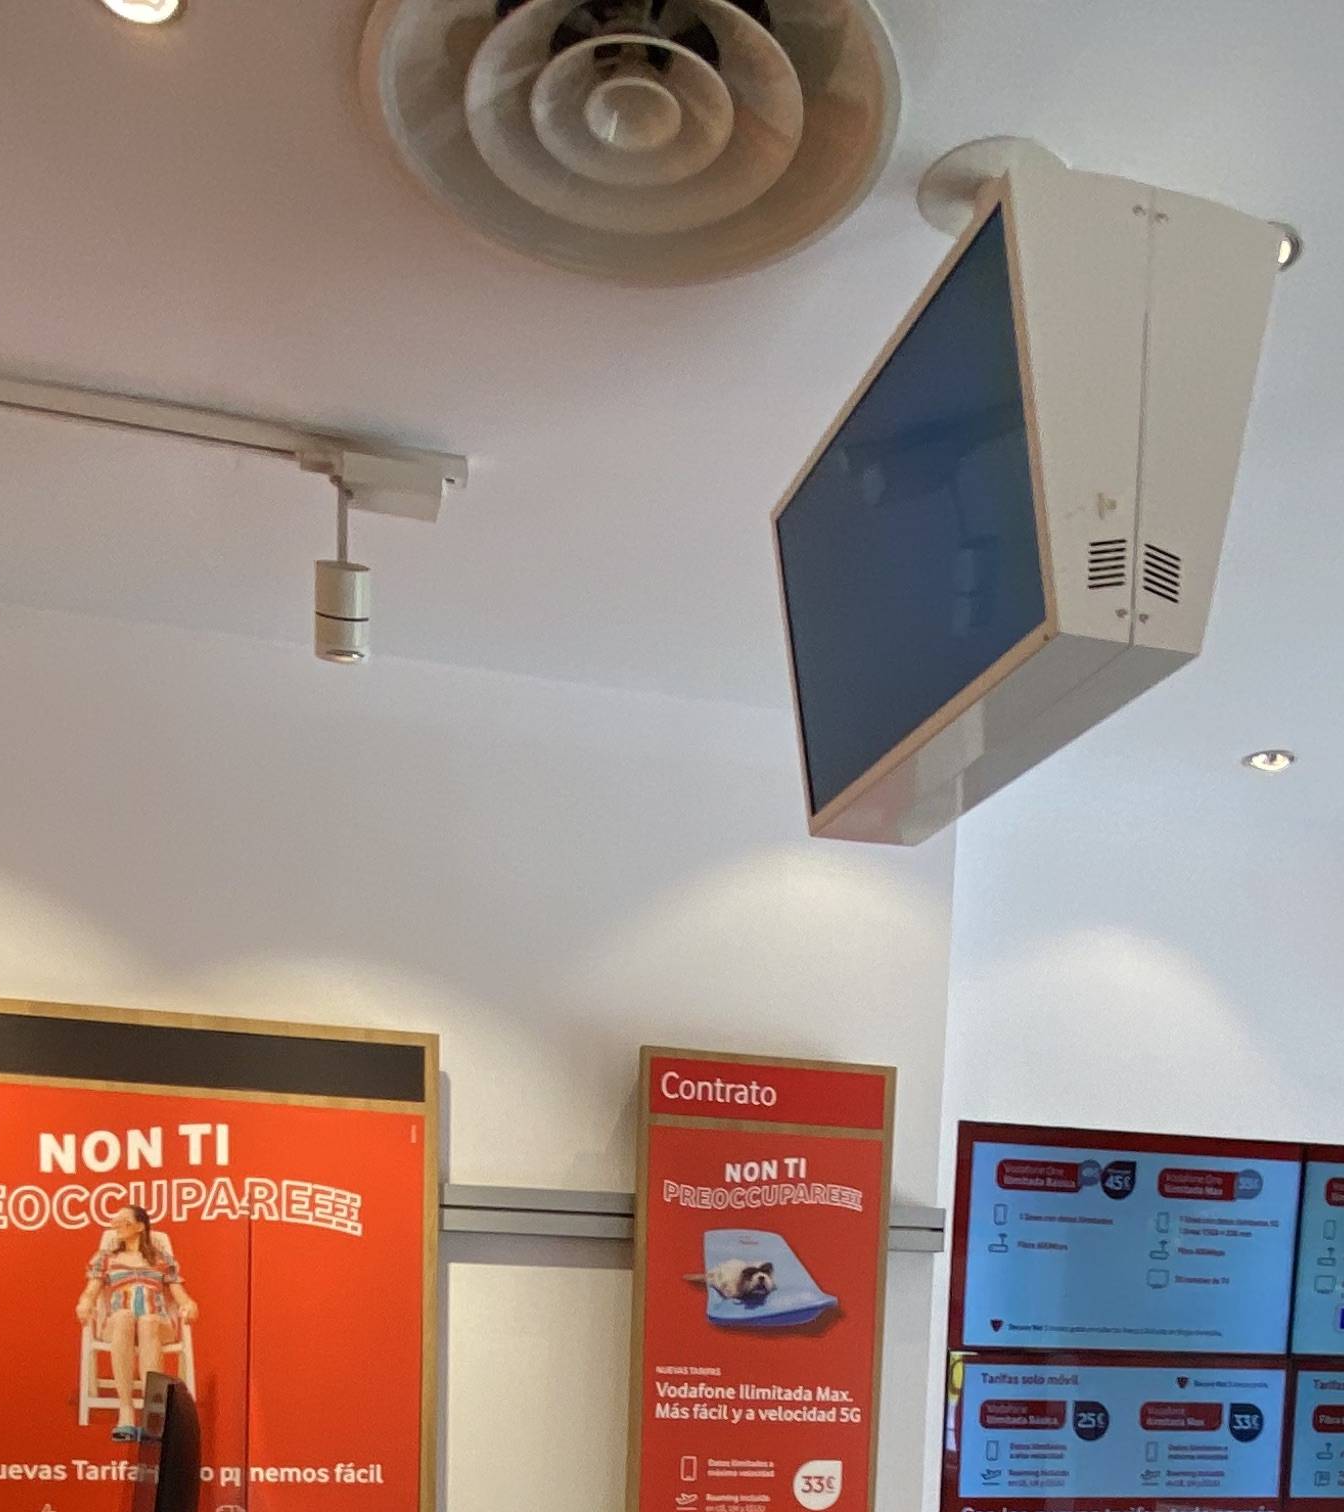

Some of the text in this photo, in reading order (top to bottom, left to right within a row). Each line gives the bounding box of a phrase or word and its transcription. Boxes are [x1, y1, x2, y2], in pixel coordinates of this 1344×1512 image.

[661, 1071, 777, 1106] Contrato
[39, 1123, 229, 1174] NON TI
[725, 1157, 807, 1183] NON TI
[981, 1372, 1079, 1386] Tarifas solo móvil
[656, 1381, 854, 1402] Vodafone Ilimitada Max.
[655, 1402, 862, 1424] Más fácil y a velocidad 5G
[1077, 1412, 1106, 1428] 25€
[334, 1462, 384, 1483] fácil
[801, 1475, 837, 1494] 33€
